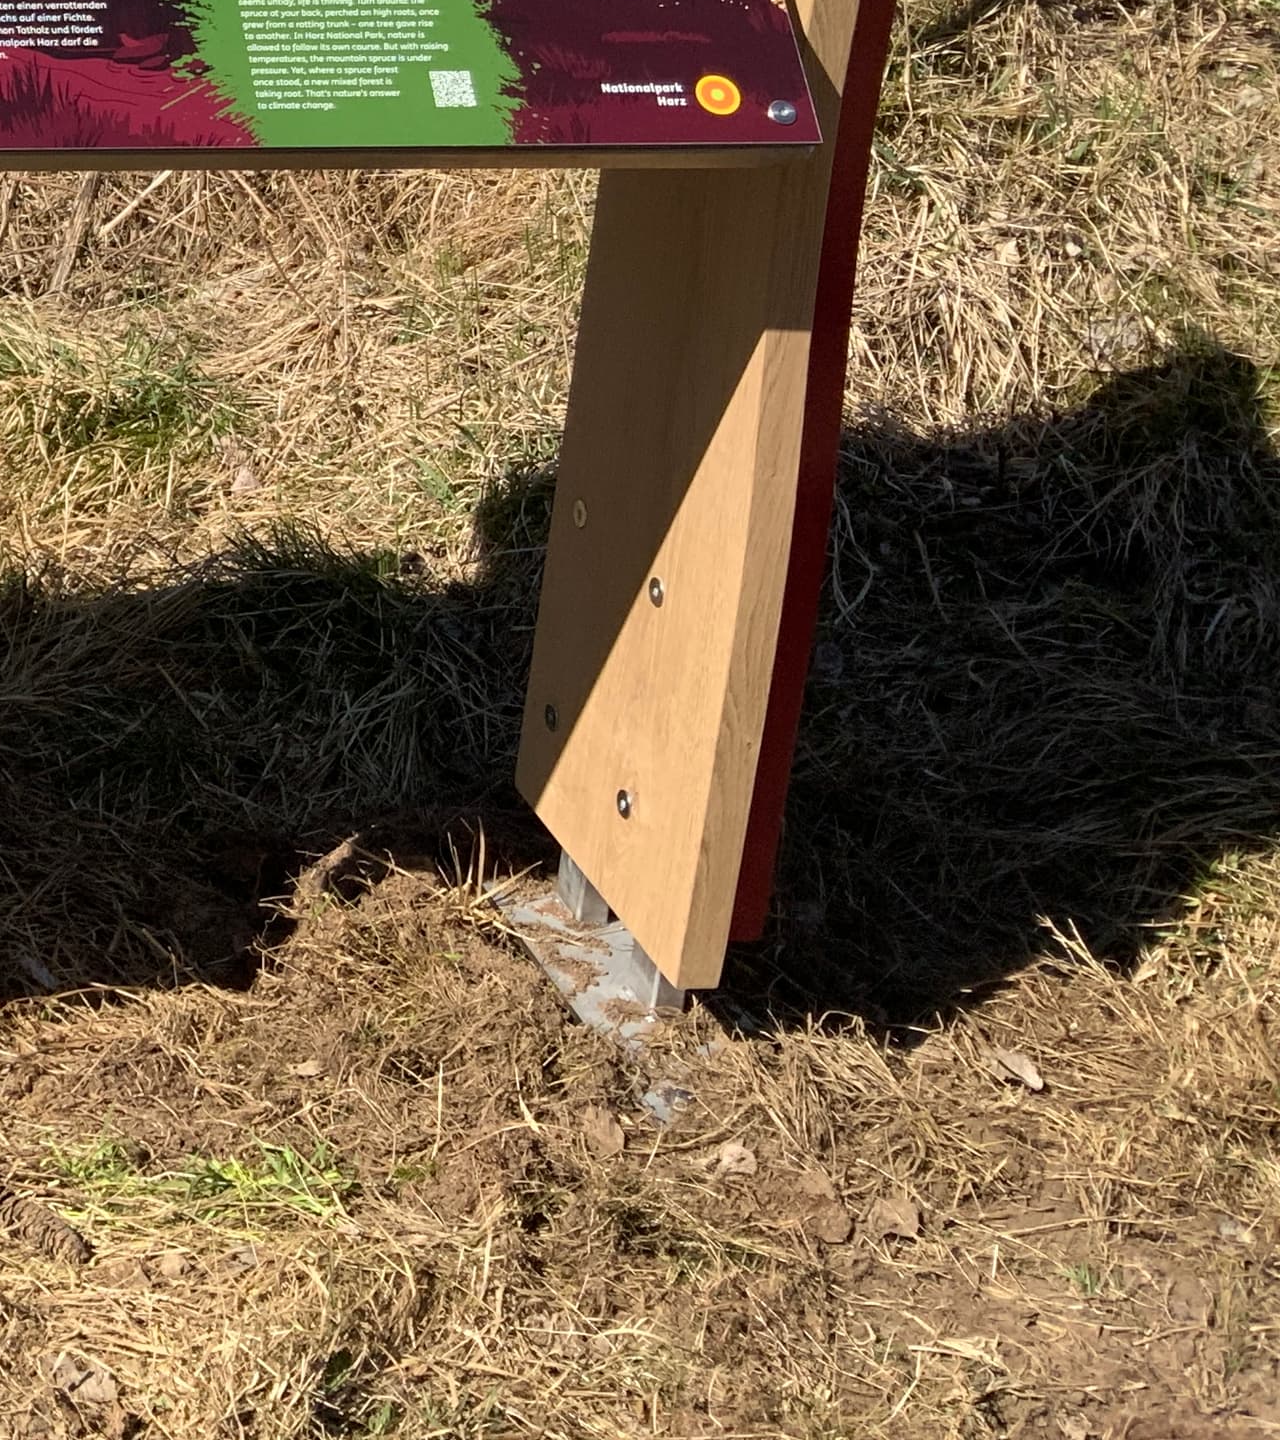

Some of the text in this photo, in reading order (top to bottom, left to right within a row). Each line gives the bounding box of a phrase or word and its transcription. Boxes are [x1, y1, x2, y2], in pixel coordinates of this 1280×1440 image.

[601, 83, 683, 94] Nationalpark
[656, 96, 687, 106] Harz
[302, 102, 336, 111] change.
